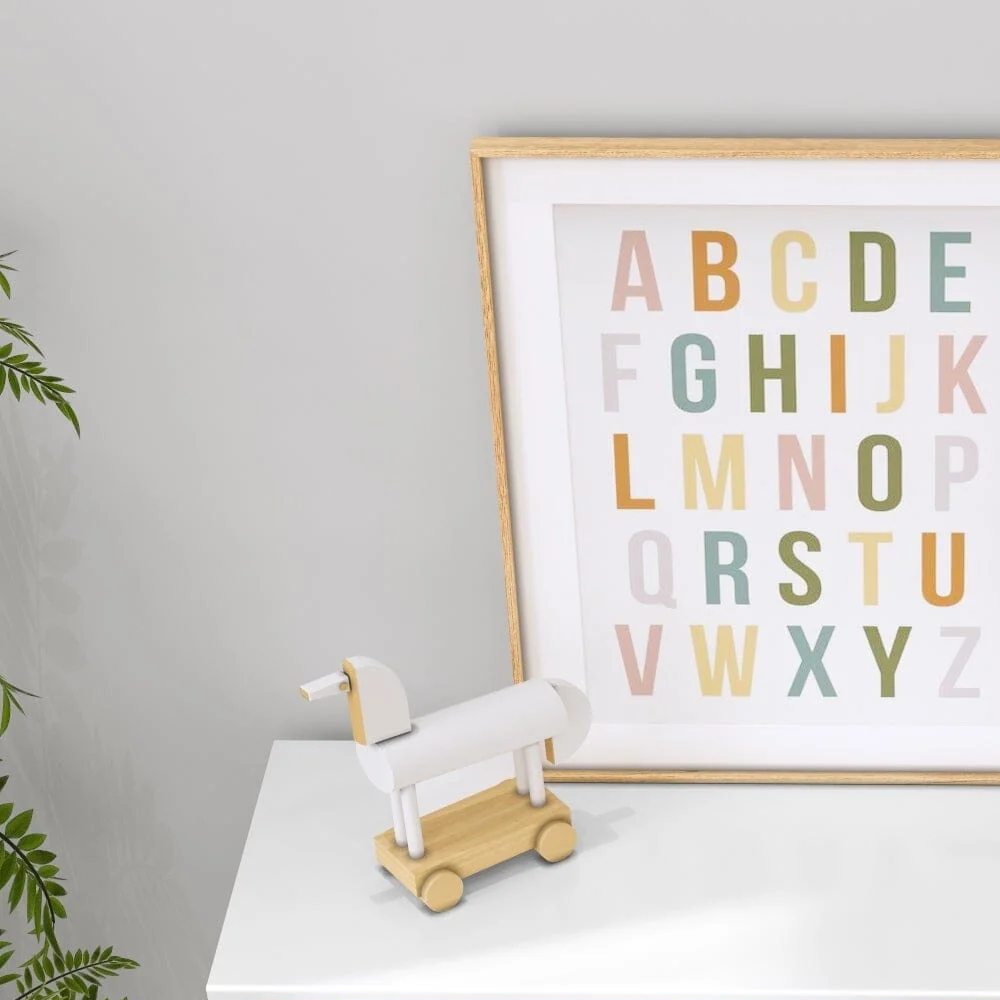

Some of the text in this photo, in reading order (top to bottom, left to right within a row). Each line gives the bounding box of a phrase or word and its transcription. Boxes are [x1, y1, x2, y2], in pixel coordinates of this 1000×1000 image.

[611, 230, 972, 313] A B C D E
[601, 333, 988, 414] F G H I J K
[612, 433, 979, 512] L M N O P
[628, 530, 966, 609] Q R S T U
[614, 624, 982, 698] V W X Y Z
